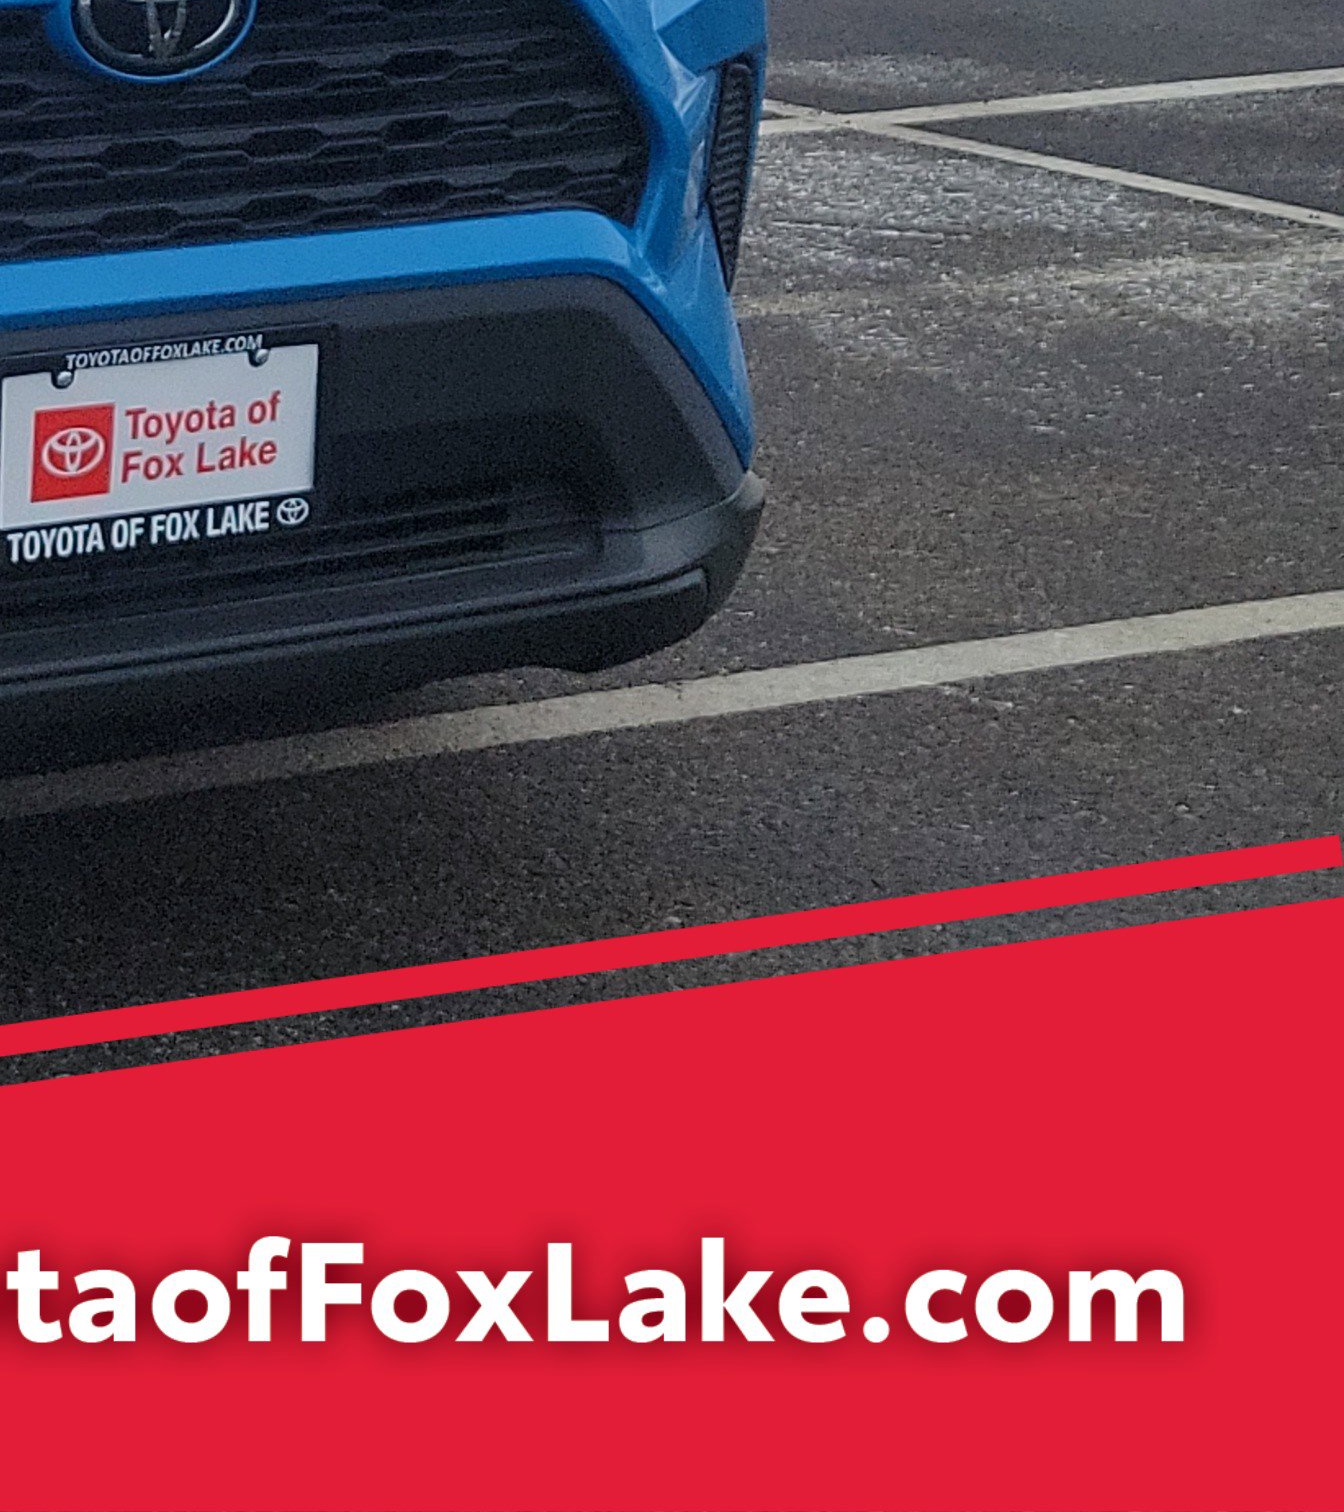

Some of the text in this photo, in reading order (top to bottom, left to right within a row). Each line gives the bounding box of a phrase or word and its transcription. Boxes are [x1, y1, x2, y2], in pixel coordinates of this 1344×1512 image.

[65, 334, 263, 370] TOYOTAOFFOXLAKE.COM
[125, 390, 281, 445] Toyota of
[121, 436, 278, 483] Fox Lake
[7, 500, 271, 563] TOYOTA OF FOX LAKE
